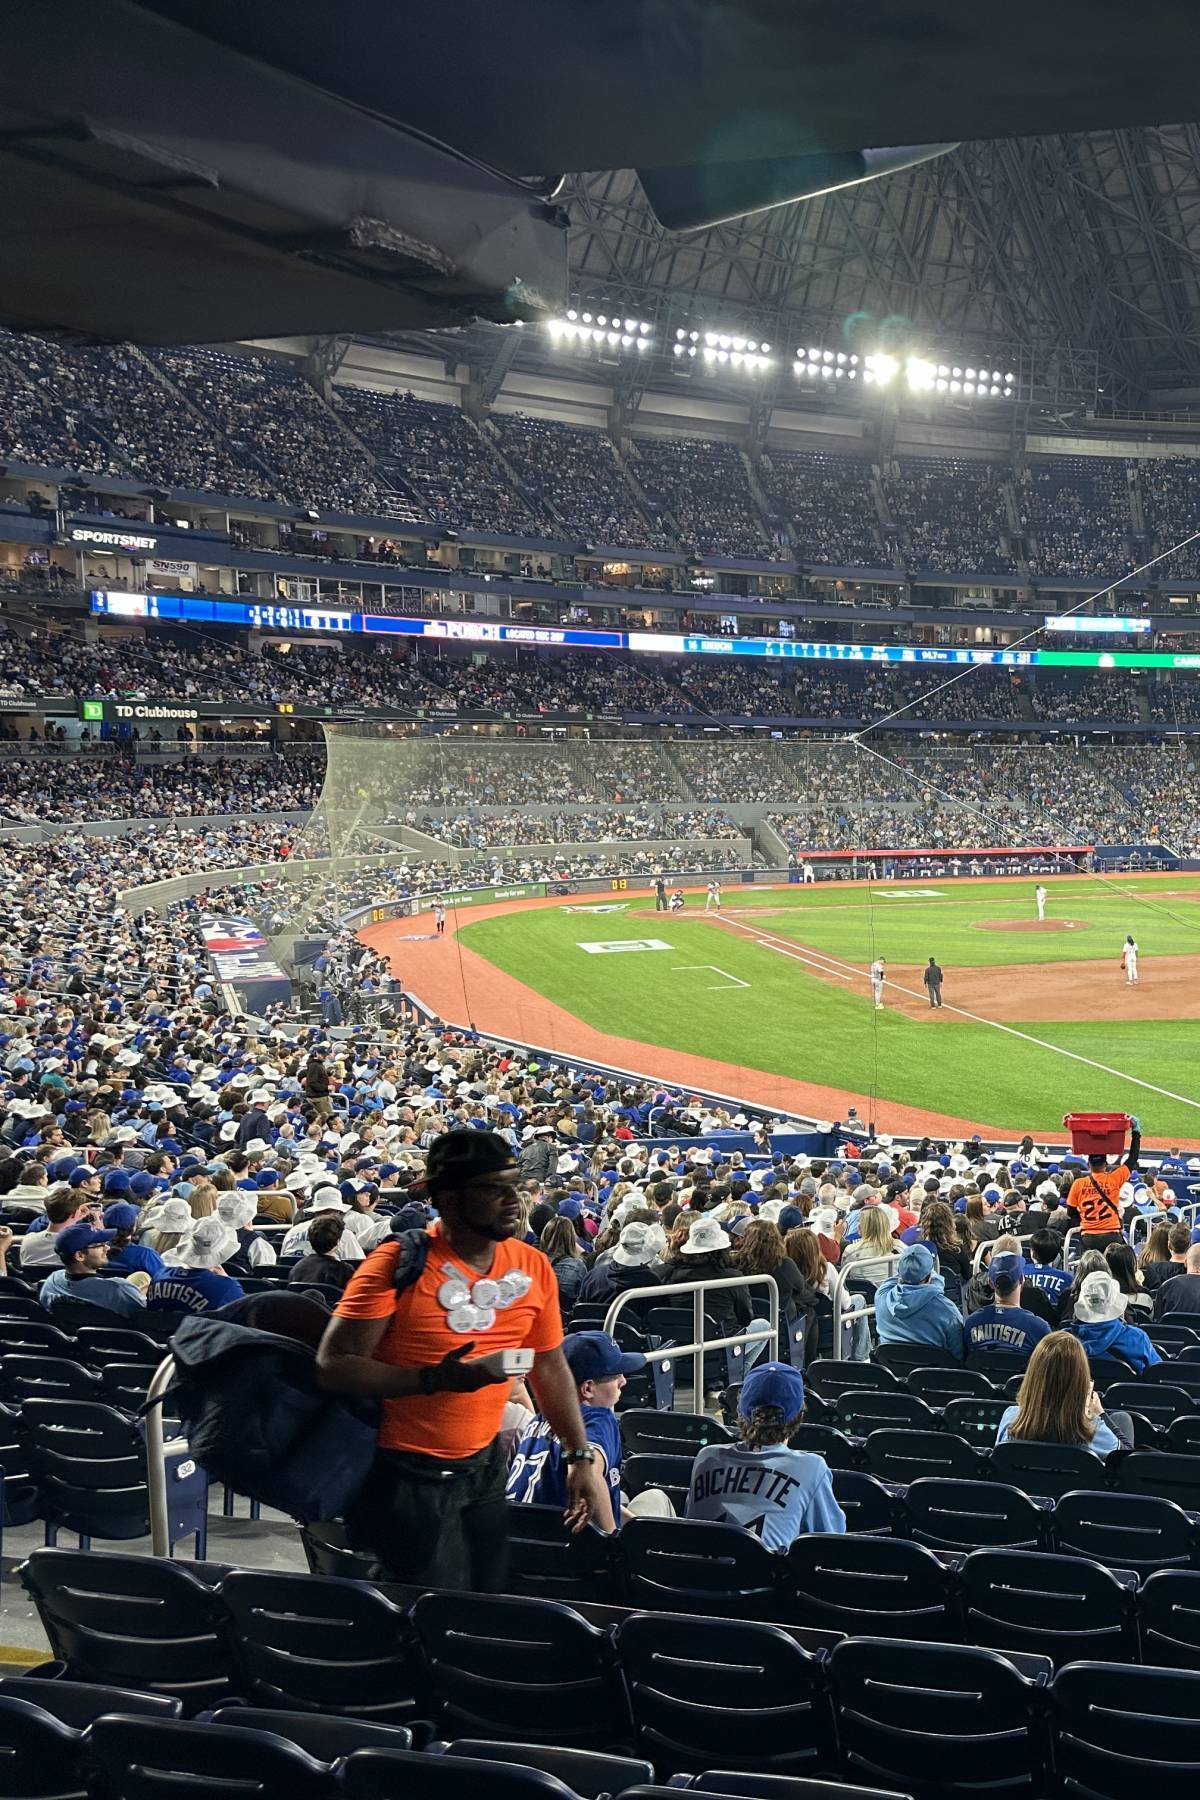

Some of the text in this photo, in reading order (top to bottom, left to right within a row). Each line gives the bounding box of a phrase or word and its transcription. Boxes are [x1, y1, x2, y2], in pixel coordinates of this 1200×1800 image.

[72, 529, 157, 549] SPORTSNET
[115, 706, 198, 718] TD Clubhouse
[1082, 1199, 1113, 1220] 22
[970, 1323, 1027, 1348] BAUTISTA
[180, 1462, 192, 1475] 32
[693, 1466, 801, 1509] BICHETTE
